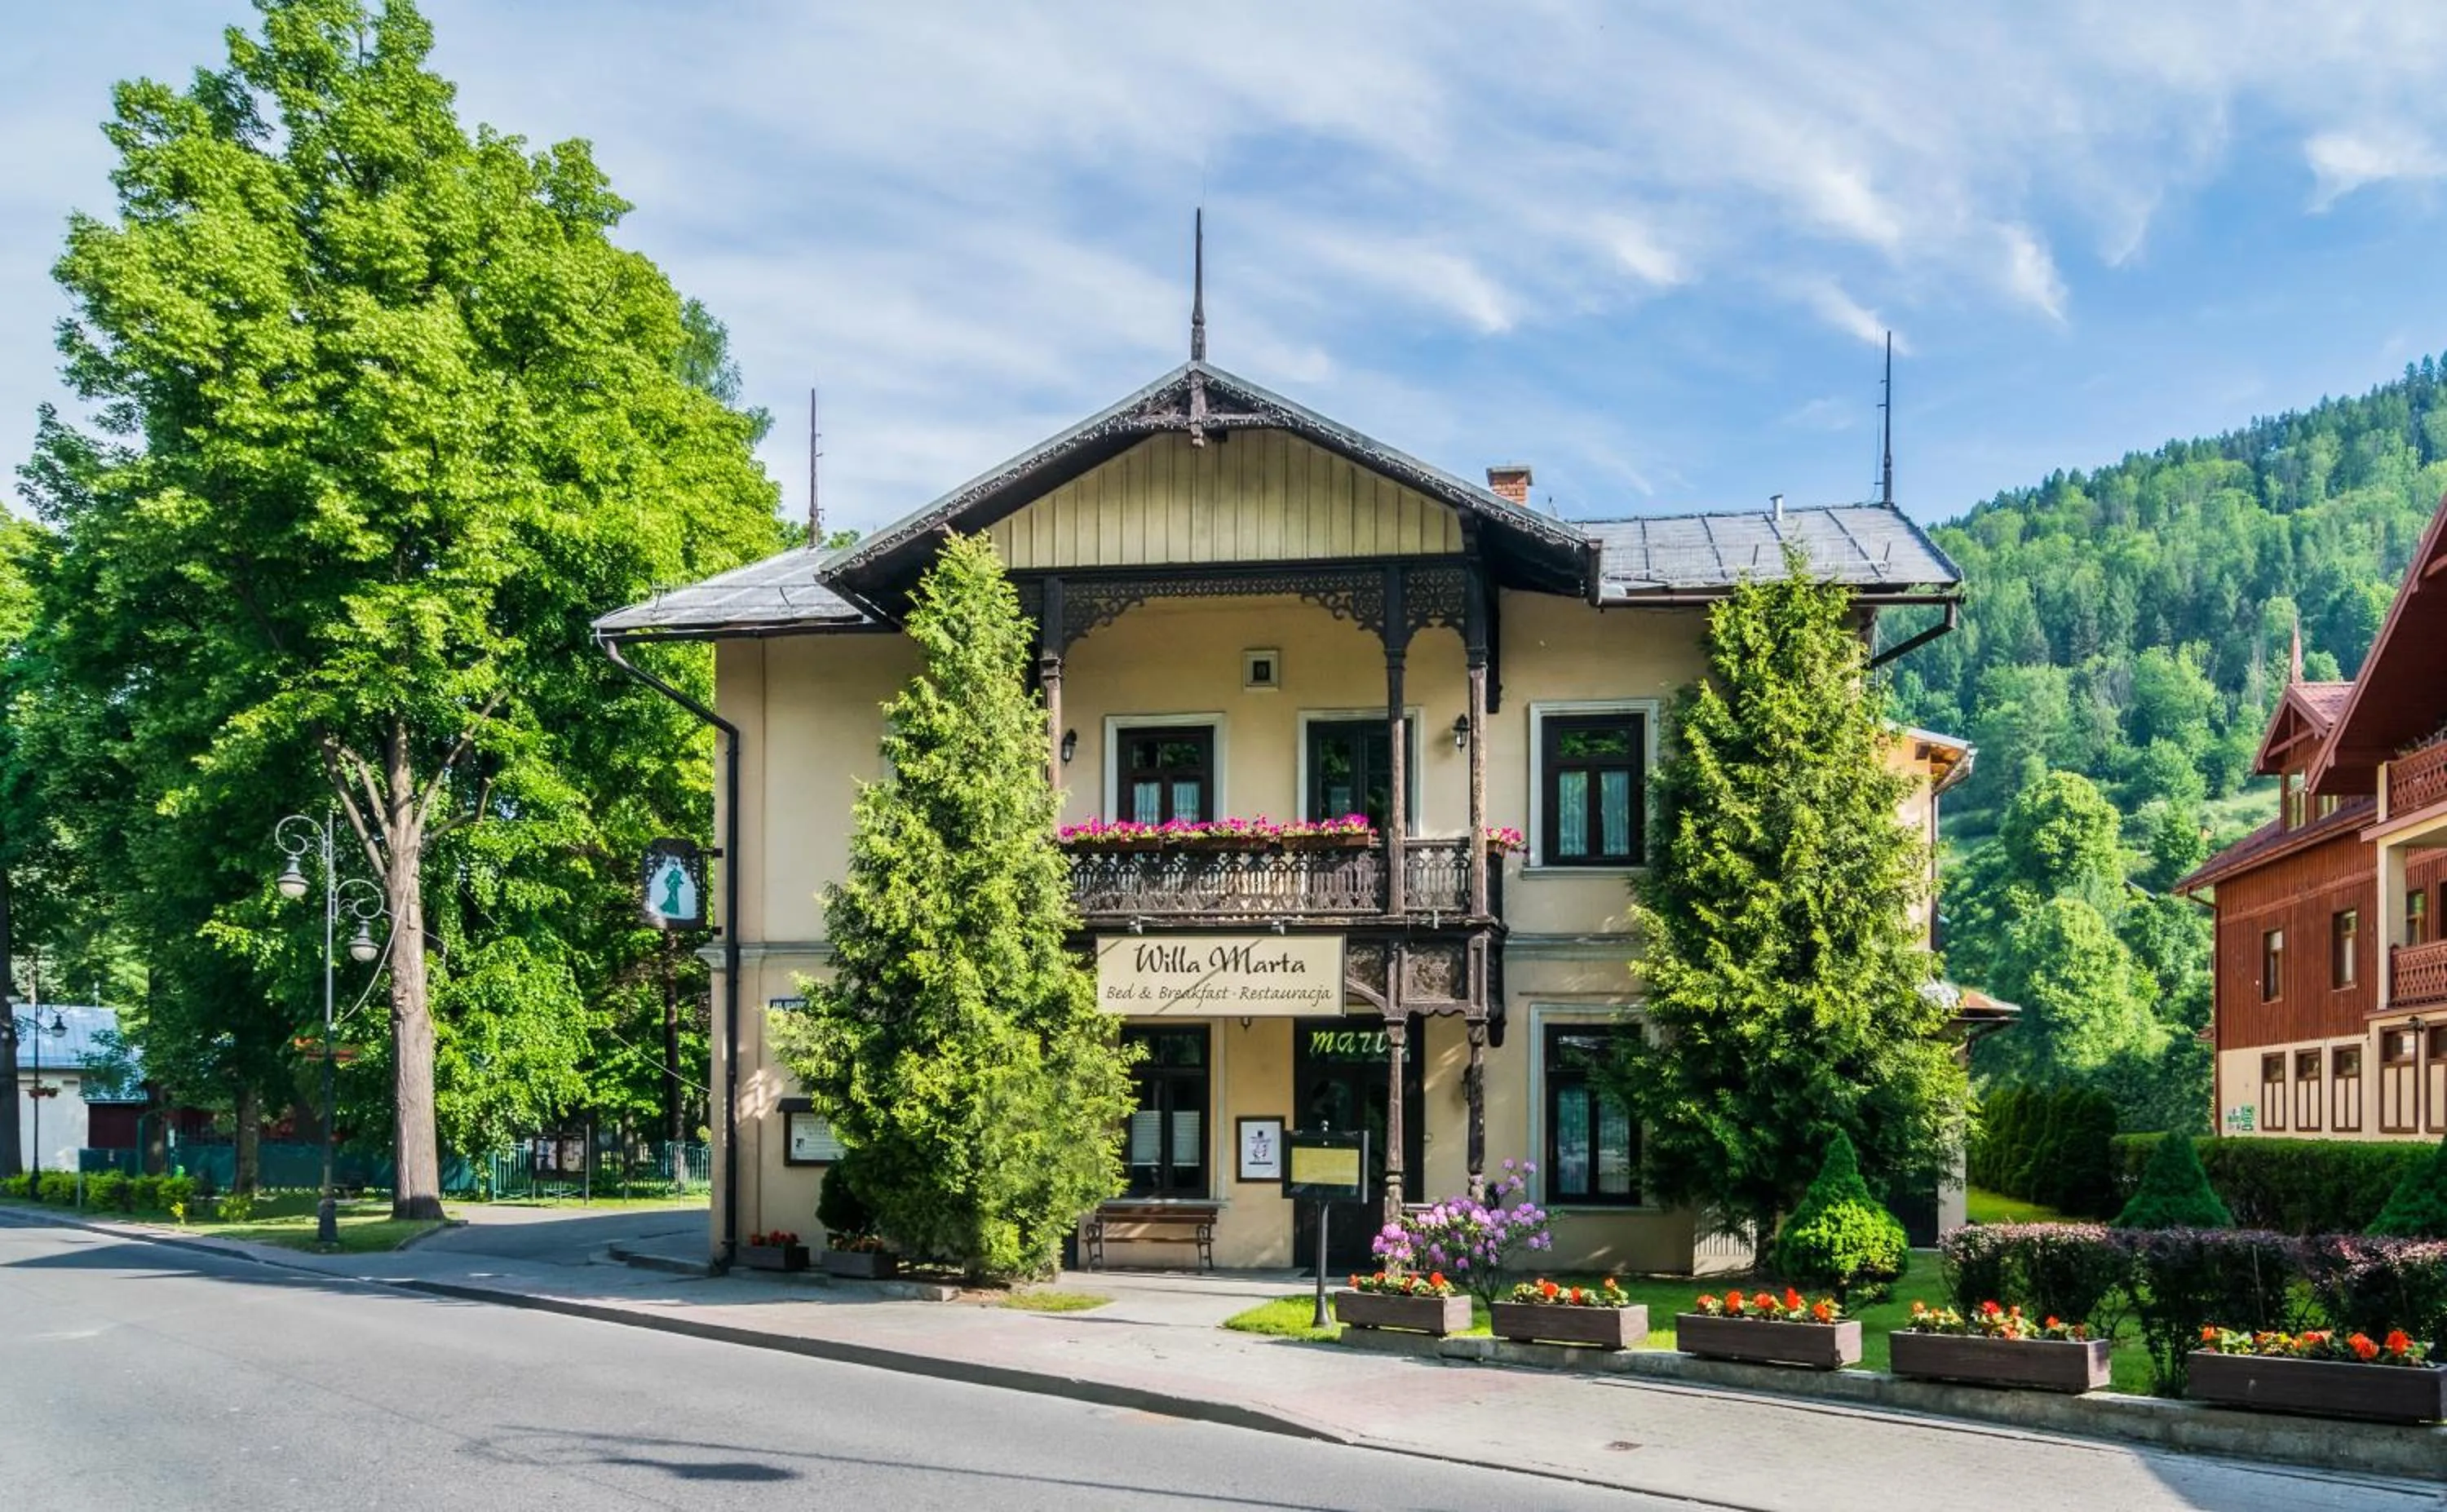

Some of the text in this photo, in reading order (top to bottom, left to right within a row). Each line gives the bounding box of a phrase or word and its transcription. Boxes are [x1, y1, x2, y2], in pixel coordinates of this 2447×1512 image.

[1134, 943, 1305, 975] Willa Marta
[1107, 983, 1135, 1000] Bed
[1139, 986, 1152, 1000] &
[1159, 983, 1228, 1008] Breakfast
[1240, 984, 1332, 1007] Restauracja
[1310, 1031, 1408, 1054] mart
